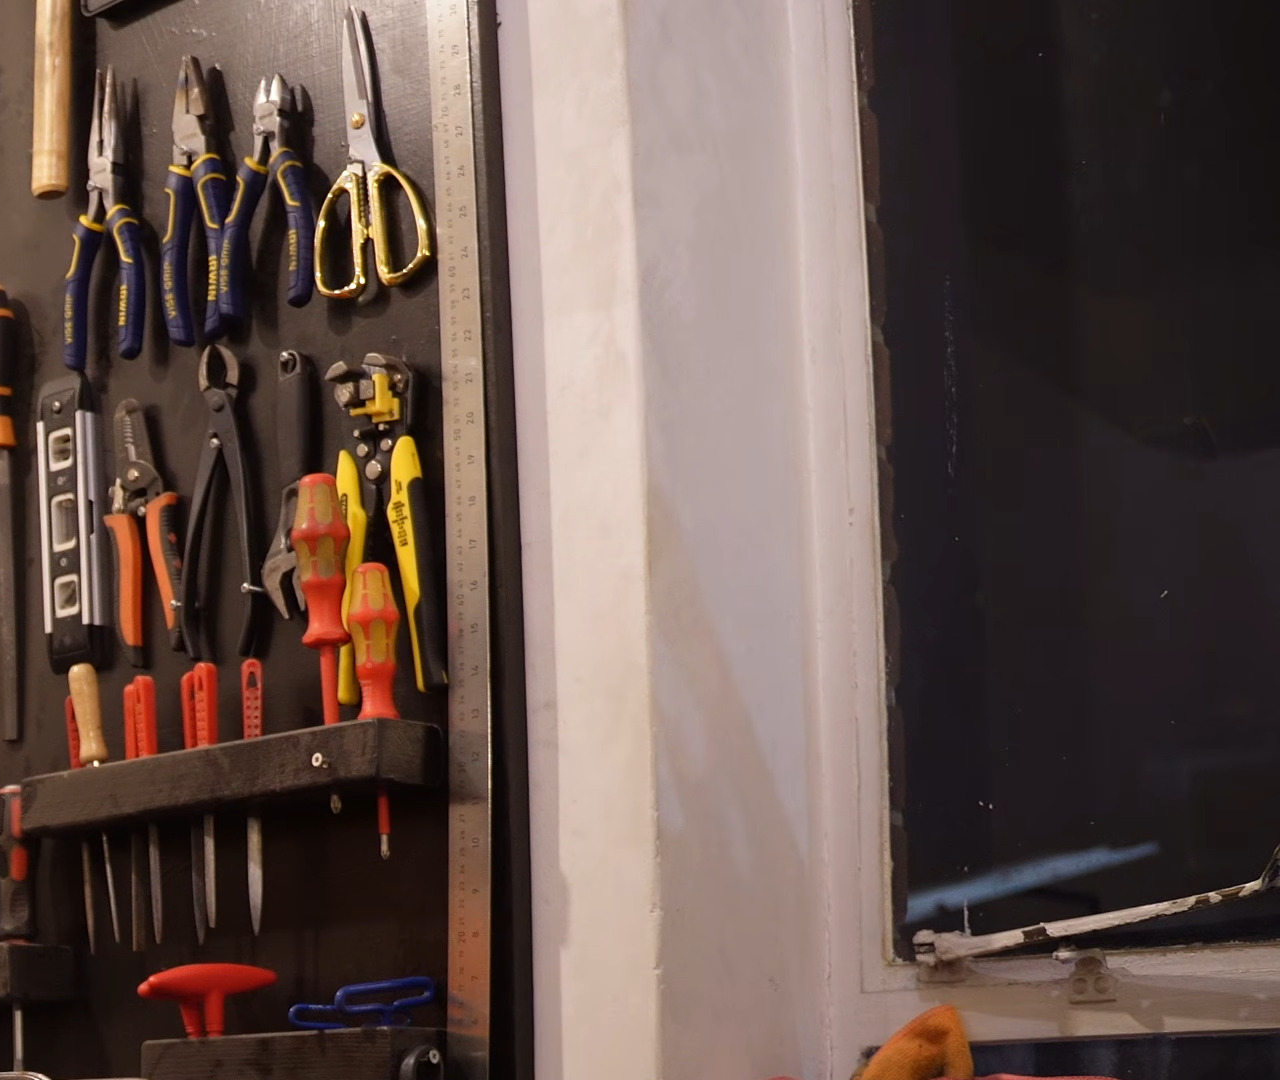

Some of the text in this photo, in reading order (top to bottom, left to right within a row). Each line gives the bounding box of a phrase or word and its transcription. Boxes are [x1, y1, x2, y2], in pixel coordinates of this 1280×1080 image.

[451, 45, 459, 56] 29
[453, 84, 461, 97] 28
[455, 126, 463, 137] 27
[459, 206, 467, 218] 25
[288, 229, 298, 271] IRWIN
[461, 246, 468, 259] 24
[208, 255, 219, 301] IRWIN
[462, 288, 470, 300] 23
[118, 284, 128, 326] IRWIN
[464, 329, 472, 341] 22
[465, 373, 473, 384] 21
[466, 412, 474, 424] 20
[453, 429, 461, 441] 50
[467, 455, 474, 464] 19
[468, 496, 476, 507] 18
[469, 539, 477, 549] 17
[470, 580, 478, 591] 16
[455, 594, 464, 607] 40
[470, 623, 478, 634] 15
[471, 665, 478, 676] 14
[472, 837, 480, 848] 10
[457, 931, 466, 944] 20
